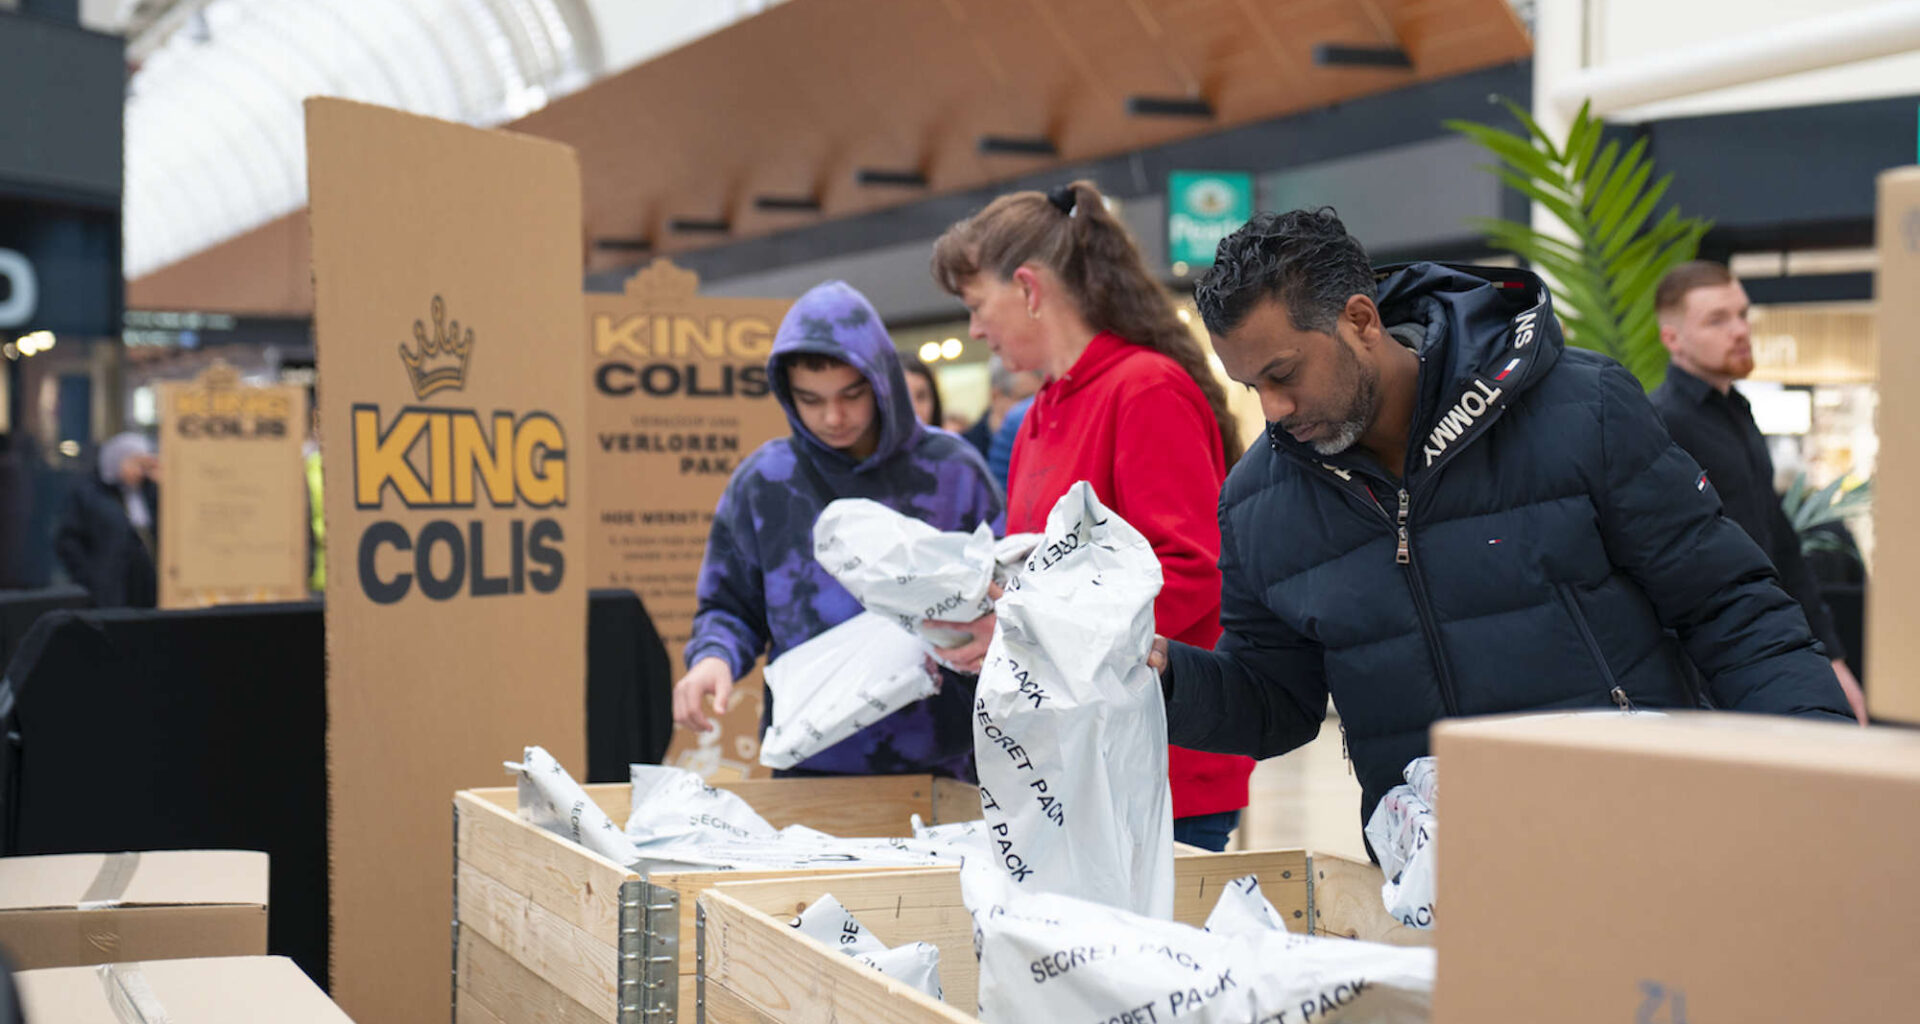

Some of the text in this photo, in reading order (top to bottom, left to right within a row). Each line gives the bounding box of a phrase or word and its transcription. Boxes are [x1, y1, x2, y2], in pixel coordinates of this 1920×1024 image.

[593, 313, 773, 358] KING
[594, 362, 771, 397] COLIS
[598, 432, 739, 452] VERLOREN
[1423, 379, 1501, 467] TOMMY
[352, 403, 567, 510] KING
[358, 518, 565, 605] COLIS
[925, 589, 967, 620] PACK
[976, 697, 1034, 771] SECRET
[992, 822, 1034, 883] PACK
